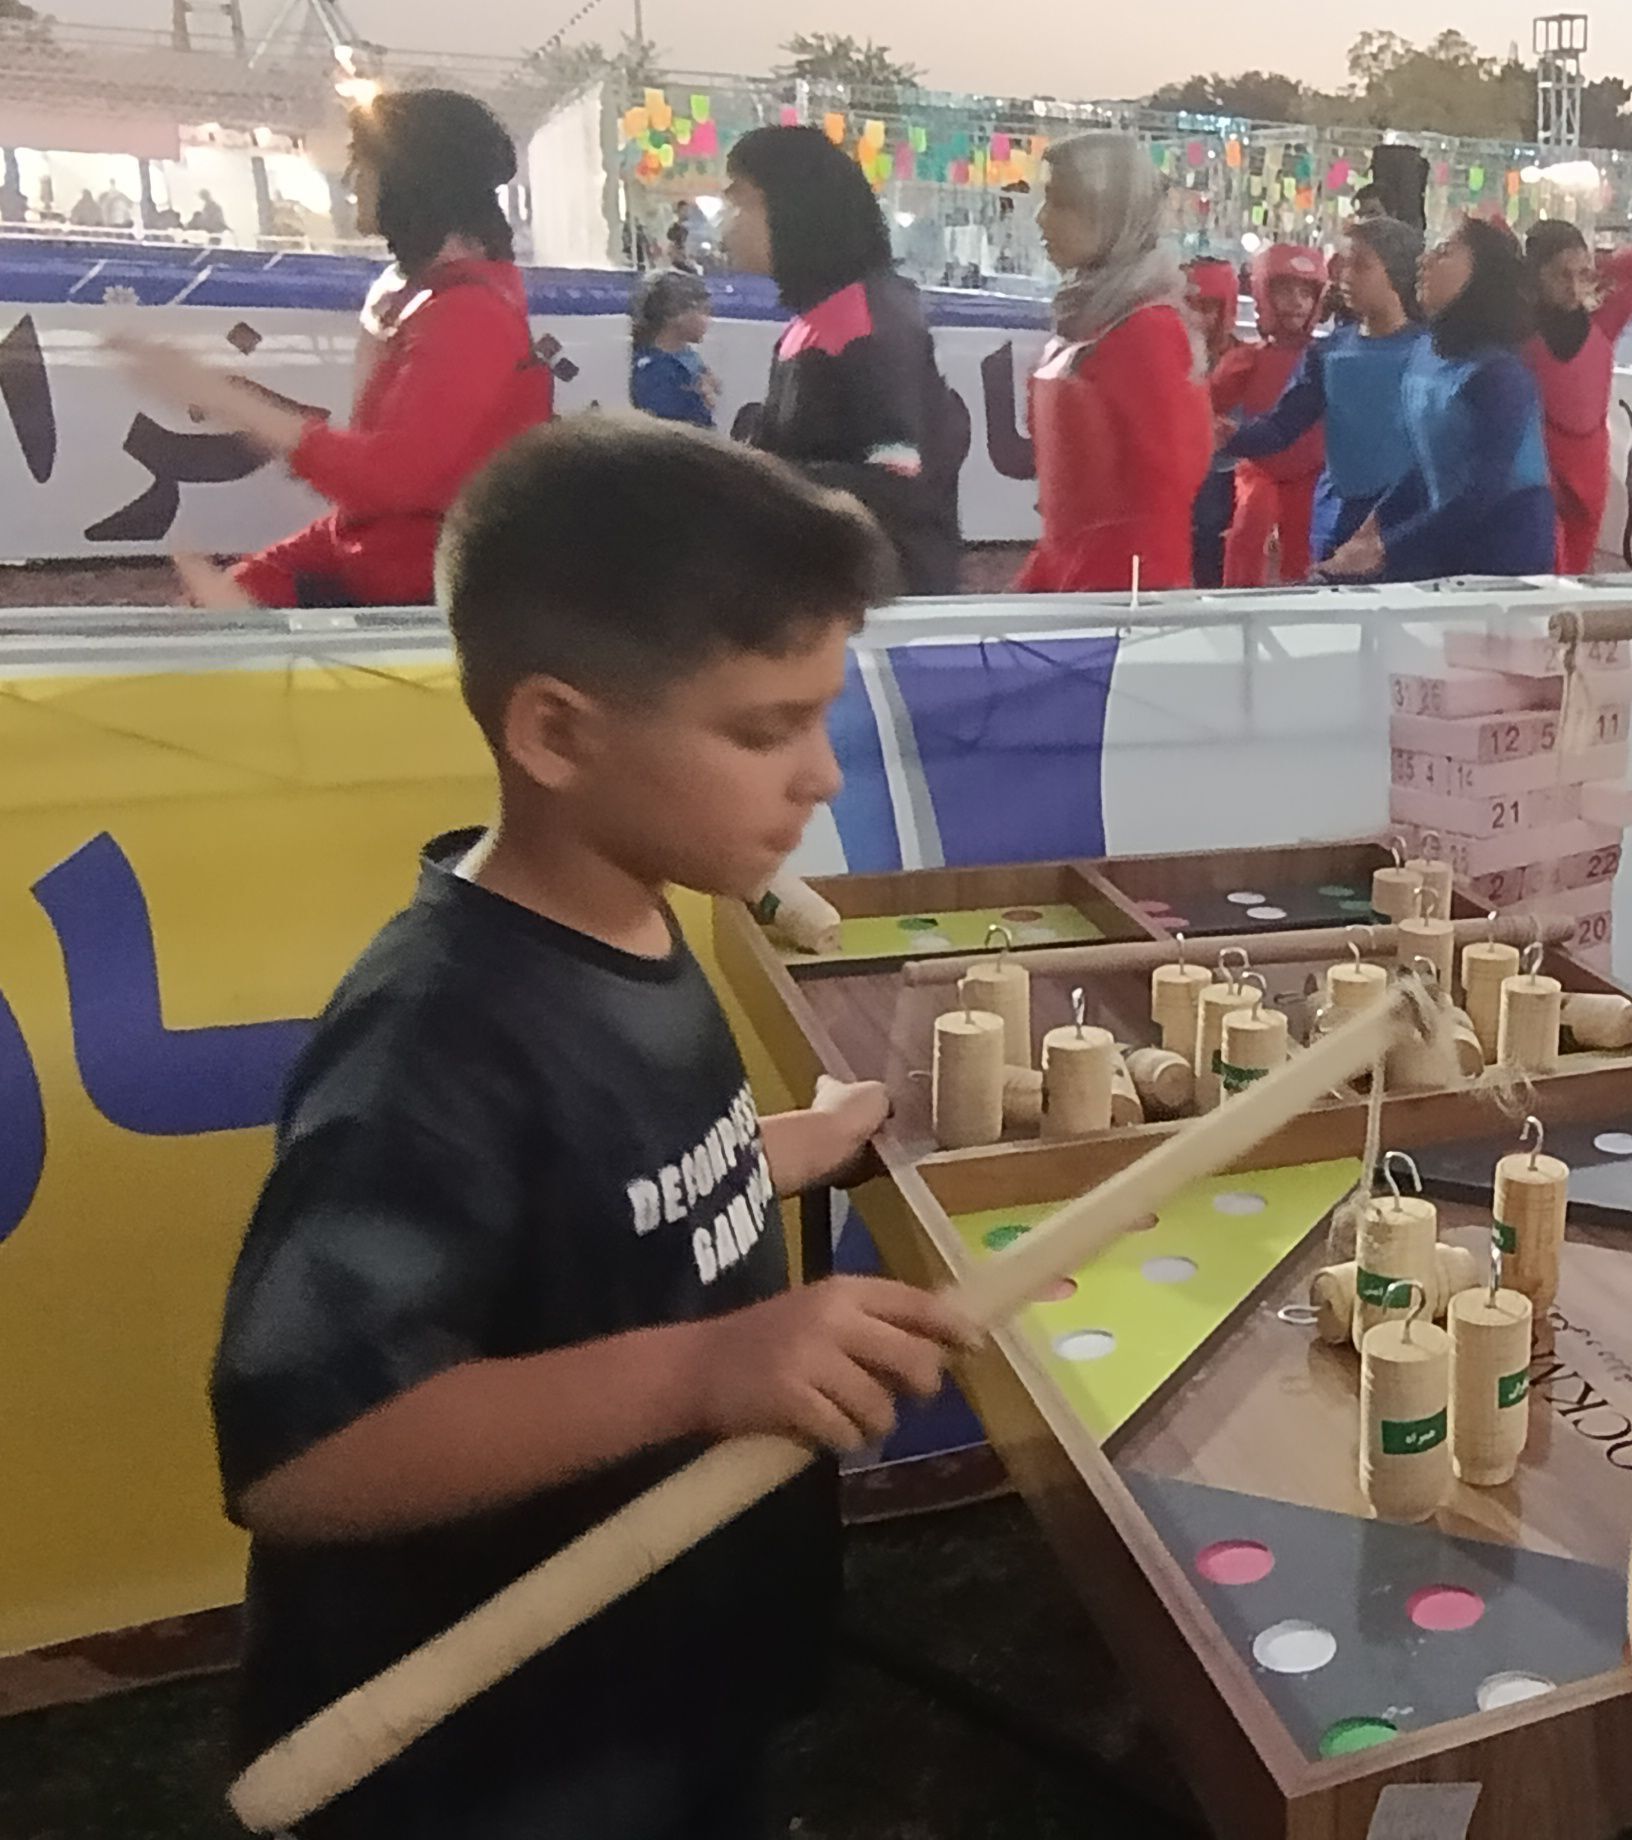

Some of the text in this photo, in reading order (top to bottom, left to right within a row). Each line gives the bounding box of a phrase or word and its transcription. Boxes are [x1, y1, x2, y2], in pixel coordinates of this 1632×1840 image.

[1490, 726, 1520, 754] 12
[1597, 713, 1618, 740] 11
[1491, 801, 1520, 829] 21
[1586, 852, 1618, 879] 22
[1578, 917, 1607, 945] 20
